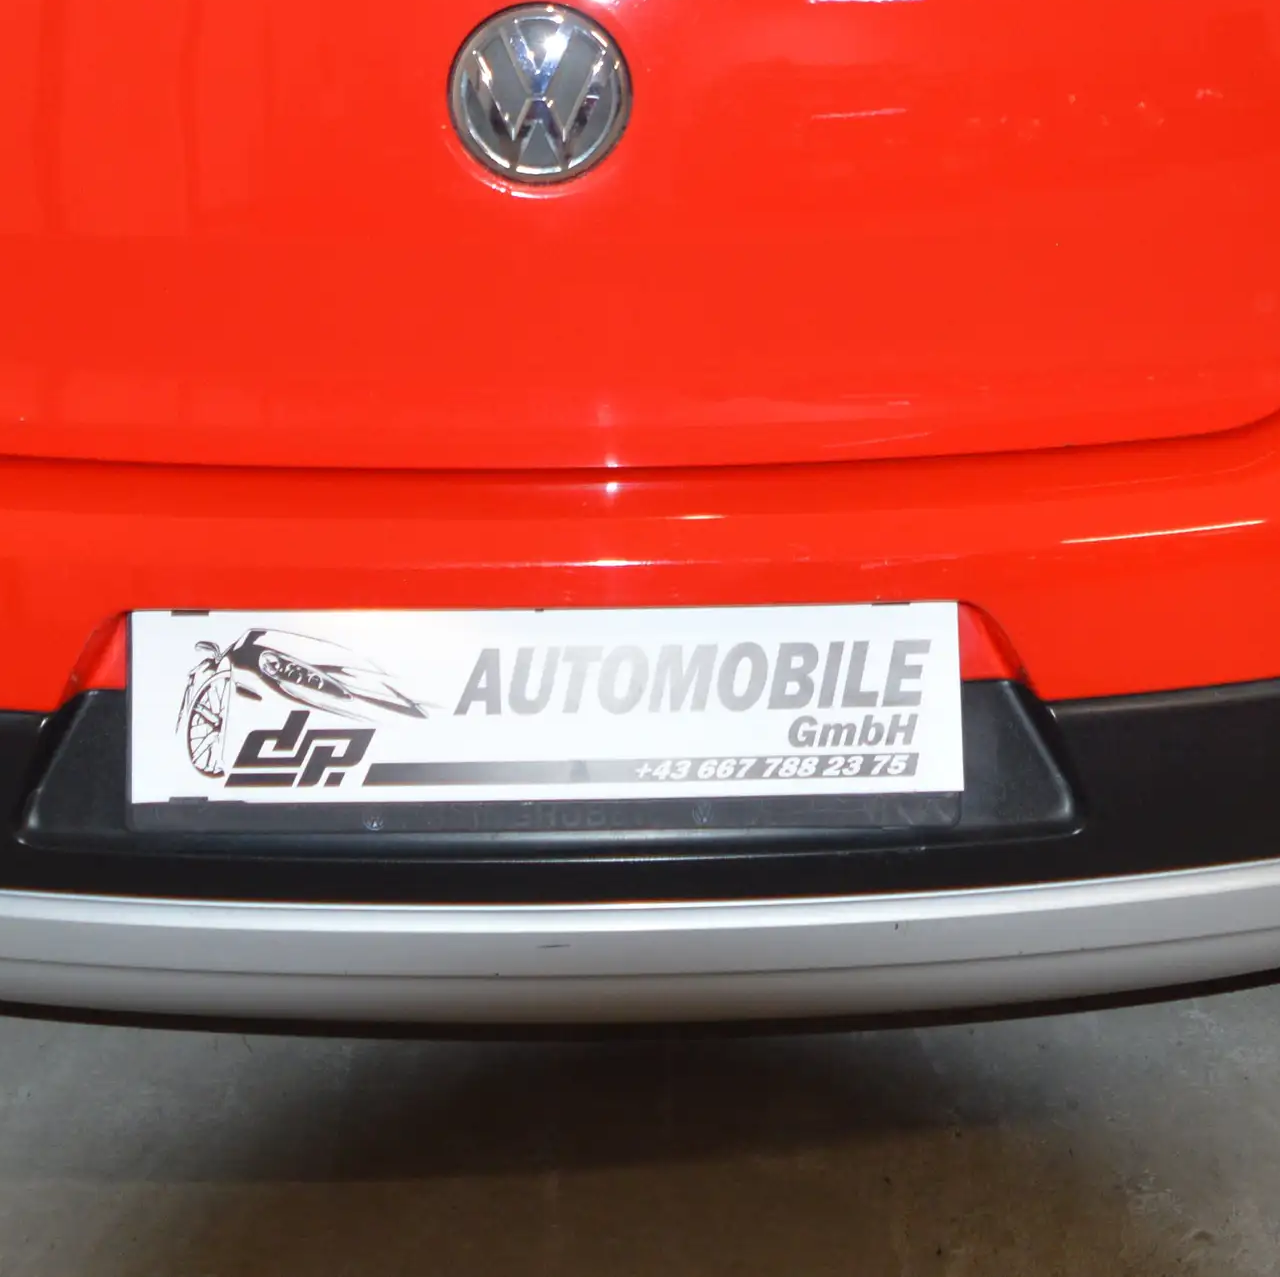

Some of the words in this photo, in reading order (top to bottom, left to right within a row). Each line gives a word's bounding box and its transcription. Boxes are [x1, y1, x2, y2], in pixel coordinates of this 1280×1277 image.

[453, 639, 931, 716] AUTOMOBILE
[787, 714, 919, 749] GmbH
[634, 758, 691, 780] +43
[696, 758, 759, 779] 667
[762, 756, 819, 778] 788
[822, 755, 866, 777] 23
[871, 754, 909, 775] 75
